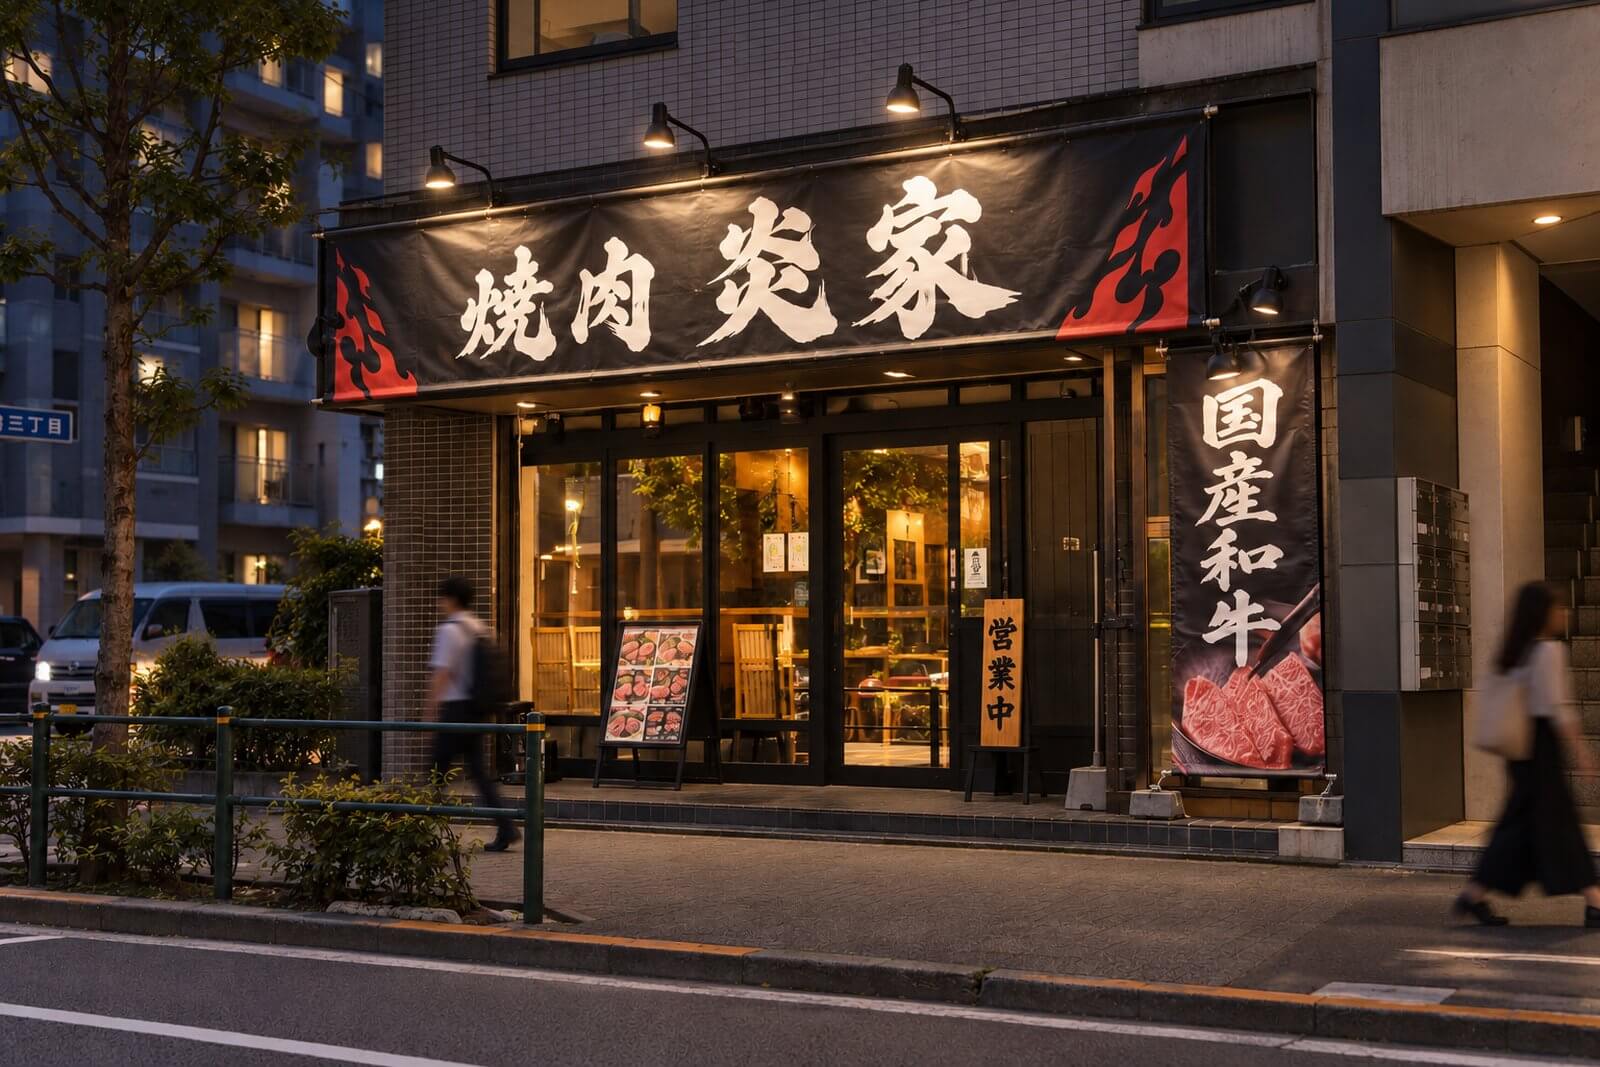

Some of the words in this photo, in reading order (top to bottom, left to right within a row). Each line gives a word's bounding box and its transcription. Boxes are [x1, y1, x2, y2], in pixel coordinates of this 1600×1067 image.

[455, 236, 655, 361] 焼肉
[696, 176, 1022, 347] 炎家
[0, 414, 62, 435] 三丁目
[1195, 377, 1284, 668] 国産和牛
[986, 616, 1018, 731] 営業中
